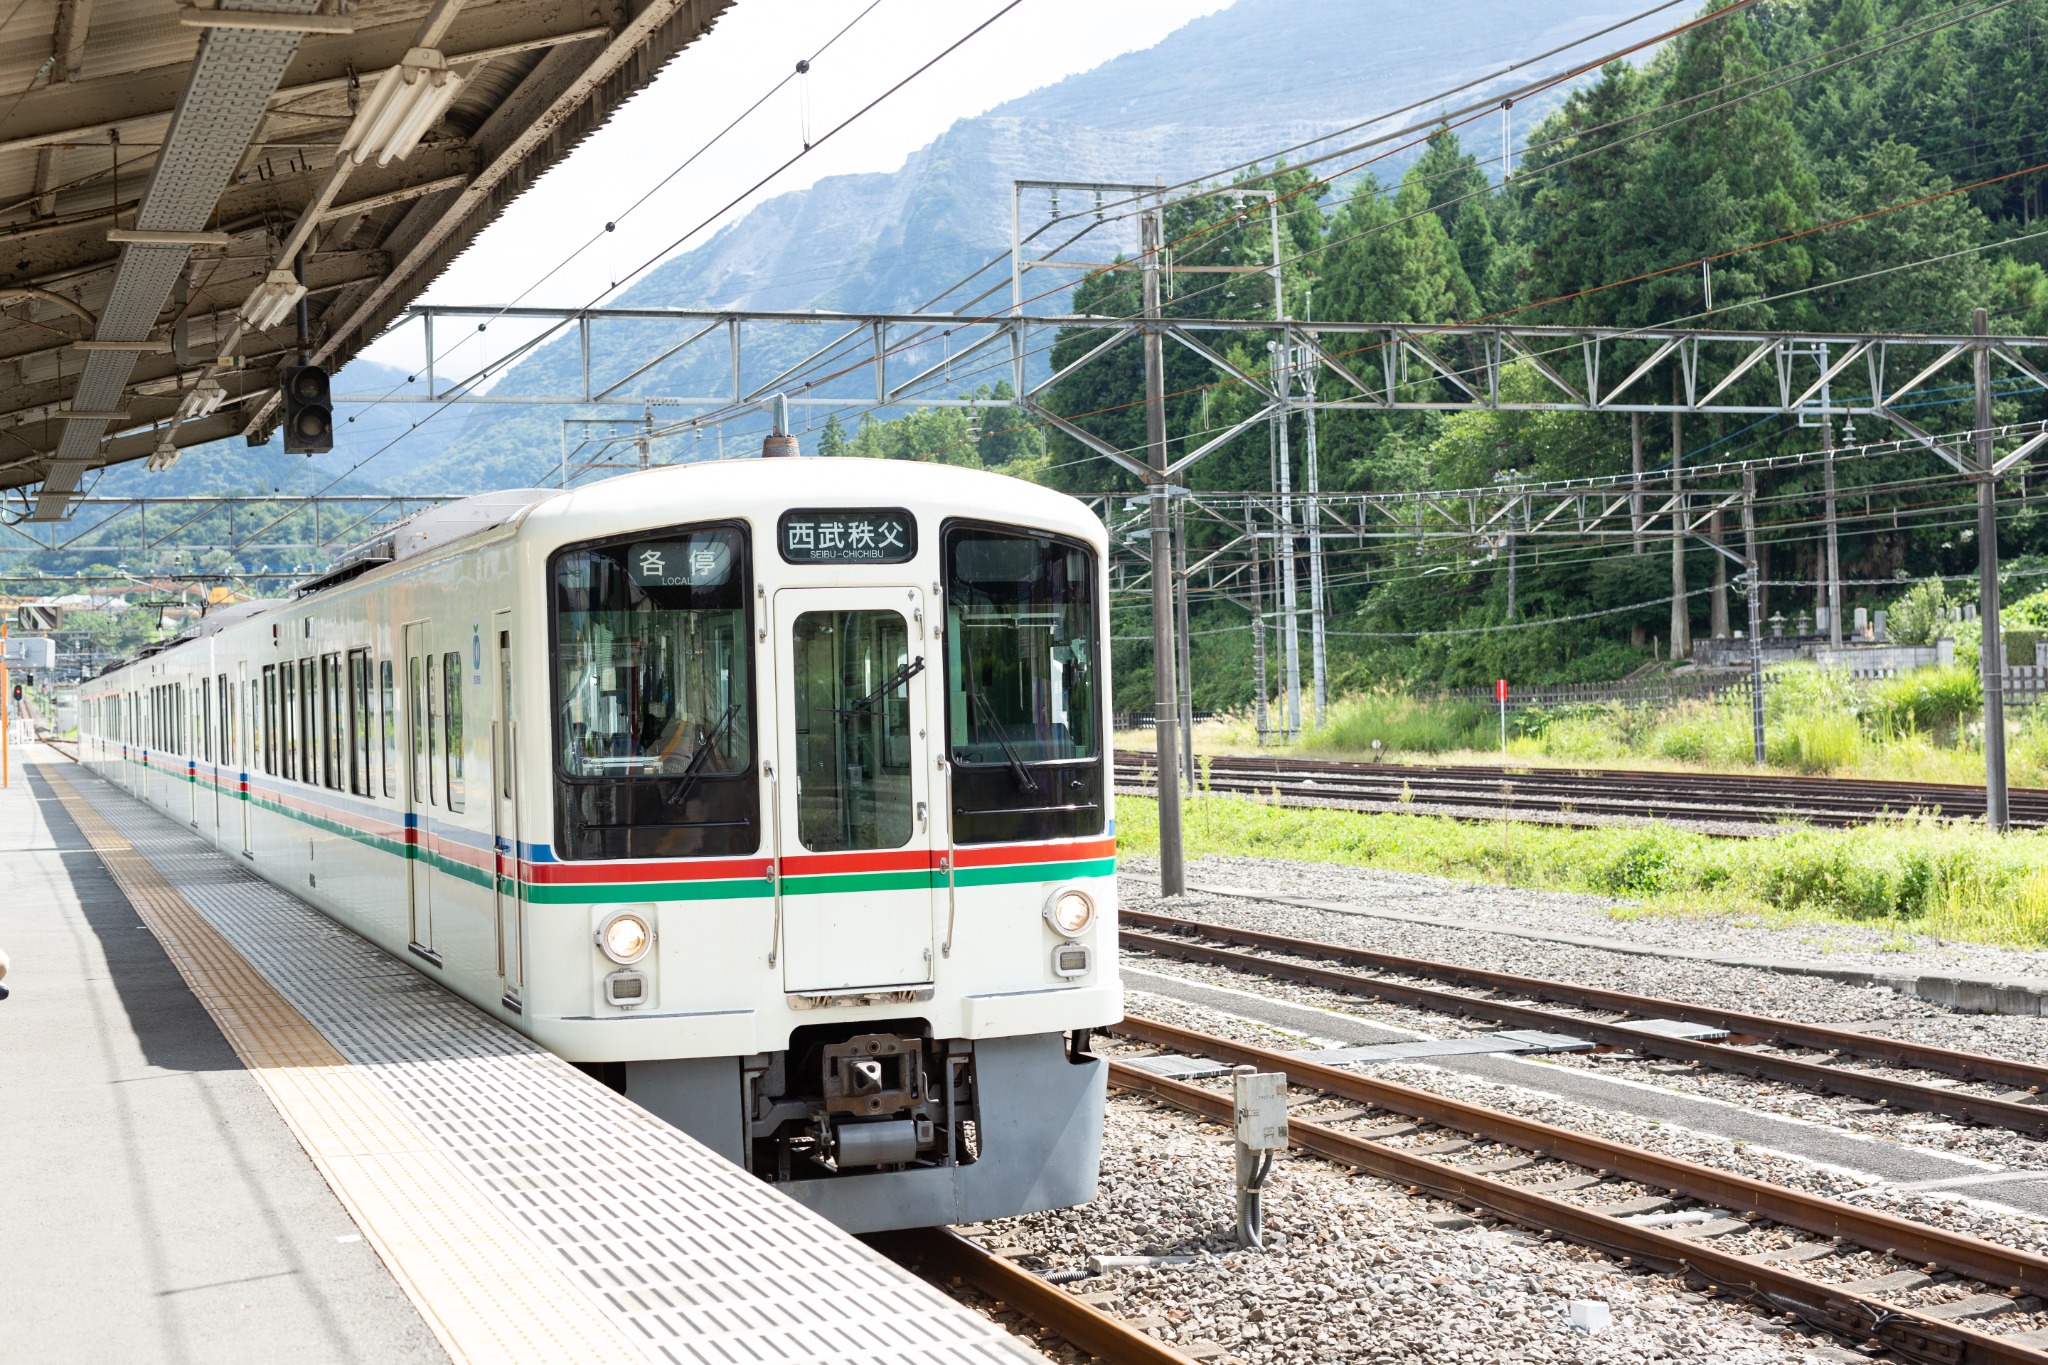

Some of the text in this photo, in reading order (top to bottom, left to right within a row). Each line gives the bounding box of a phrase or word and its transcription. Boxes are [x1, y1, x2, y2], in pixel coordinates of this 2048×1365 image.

[788, 521, 904, 549] 西武秩父
[810, 549, 884, 559] SEIBU-CHICHIBU
[661, 576, 694, 586] LOCAL
